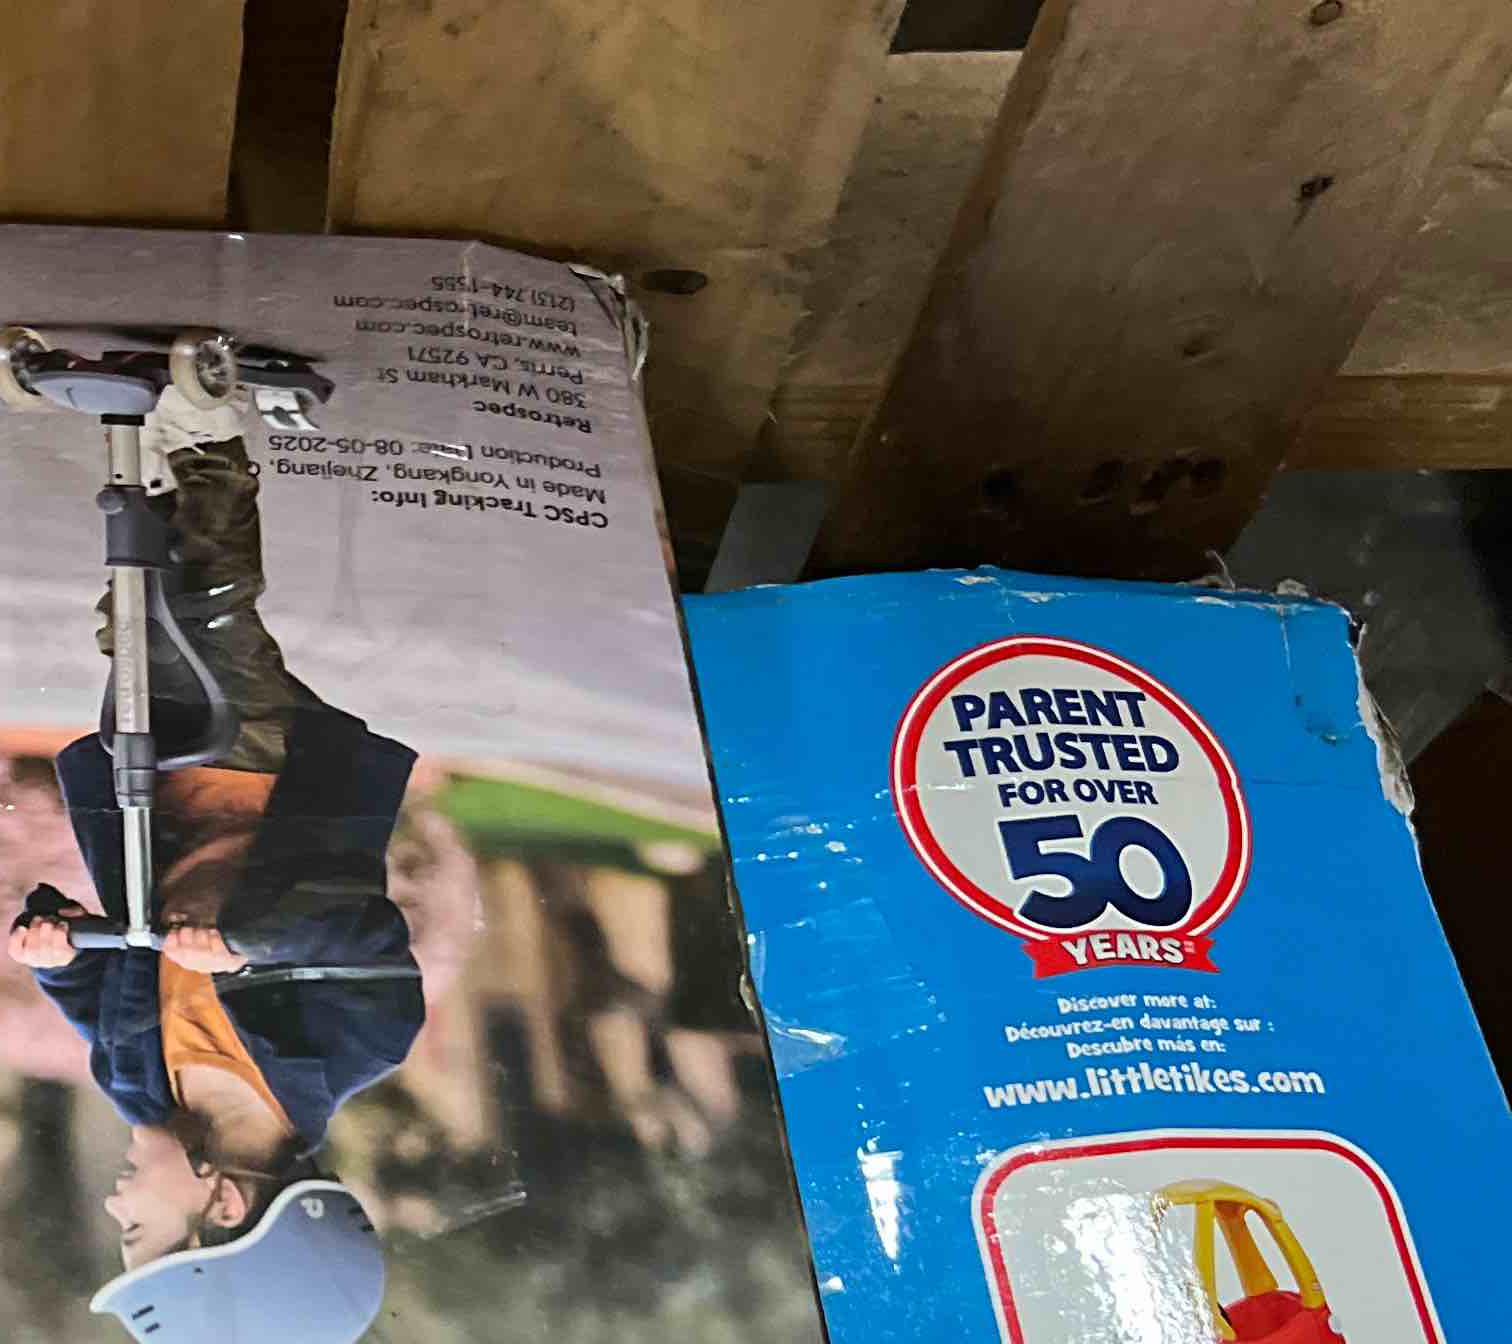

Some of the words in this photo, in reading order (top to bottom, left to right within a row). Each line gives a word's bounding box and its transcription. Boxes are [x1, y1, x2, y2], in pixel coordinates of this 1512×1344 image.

[332, 294, 578, 337] team@retrospec.com
[355, 318, 581, 357] www.retrospec.com
[407, 346, 469, 366] 92571
[474, 352, 508, 372] CA
[406, 368, 511, 395] Markham
[517, 381, 540, 399] W
[546, 389, 586, 408] 380
[473, 399, 592, 434] Retrospec
[268, 434, 403, 456] 08-05-2025
[269, 456, 379, 481] Zhejiang,
[480, 442, 602, 479] Production
[386, 463, 511, 490] Yongkang,
[514, 475, 539, 492] in
[371, 488, 428, 509] Info:
[435, 491, 537, 517] Tracking
[543, 479, 606, 505] Made
[544, 506, 609, 529] CPSC
[950, 687, 1148, 732] PARENT
[944, 733, 1180, 778] TRUSTED
[998, 780, 1069, 808] FOR
[1072, 778, 1159, 806] OVER
[996, 814, 1193, 930] 50
[1060, 933, 1185, 966] YEARS
[1057, 993, 1137, 1014] Discover
[1144, 994, 1189, 1008] more
[1193, 994, 1217, 1009] at:
[1005, 1016, 1134, 1043] Découvrez-en
[1139, 1013, 1230, 1035] davantage
[1233, 1017, 1261, 1032] sur
[1066, 1036, 1153, 1059] Descubre
[1158, 1034, 1196, 1053] más
[1200, 1039, 1227, 1053] en:
[984, 1062, 1326, 1110] www.littletikes.com
